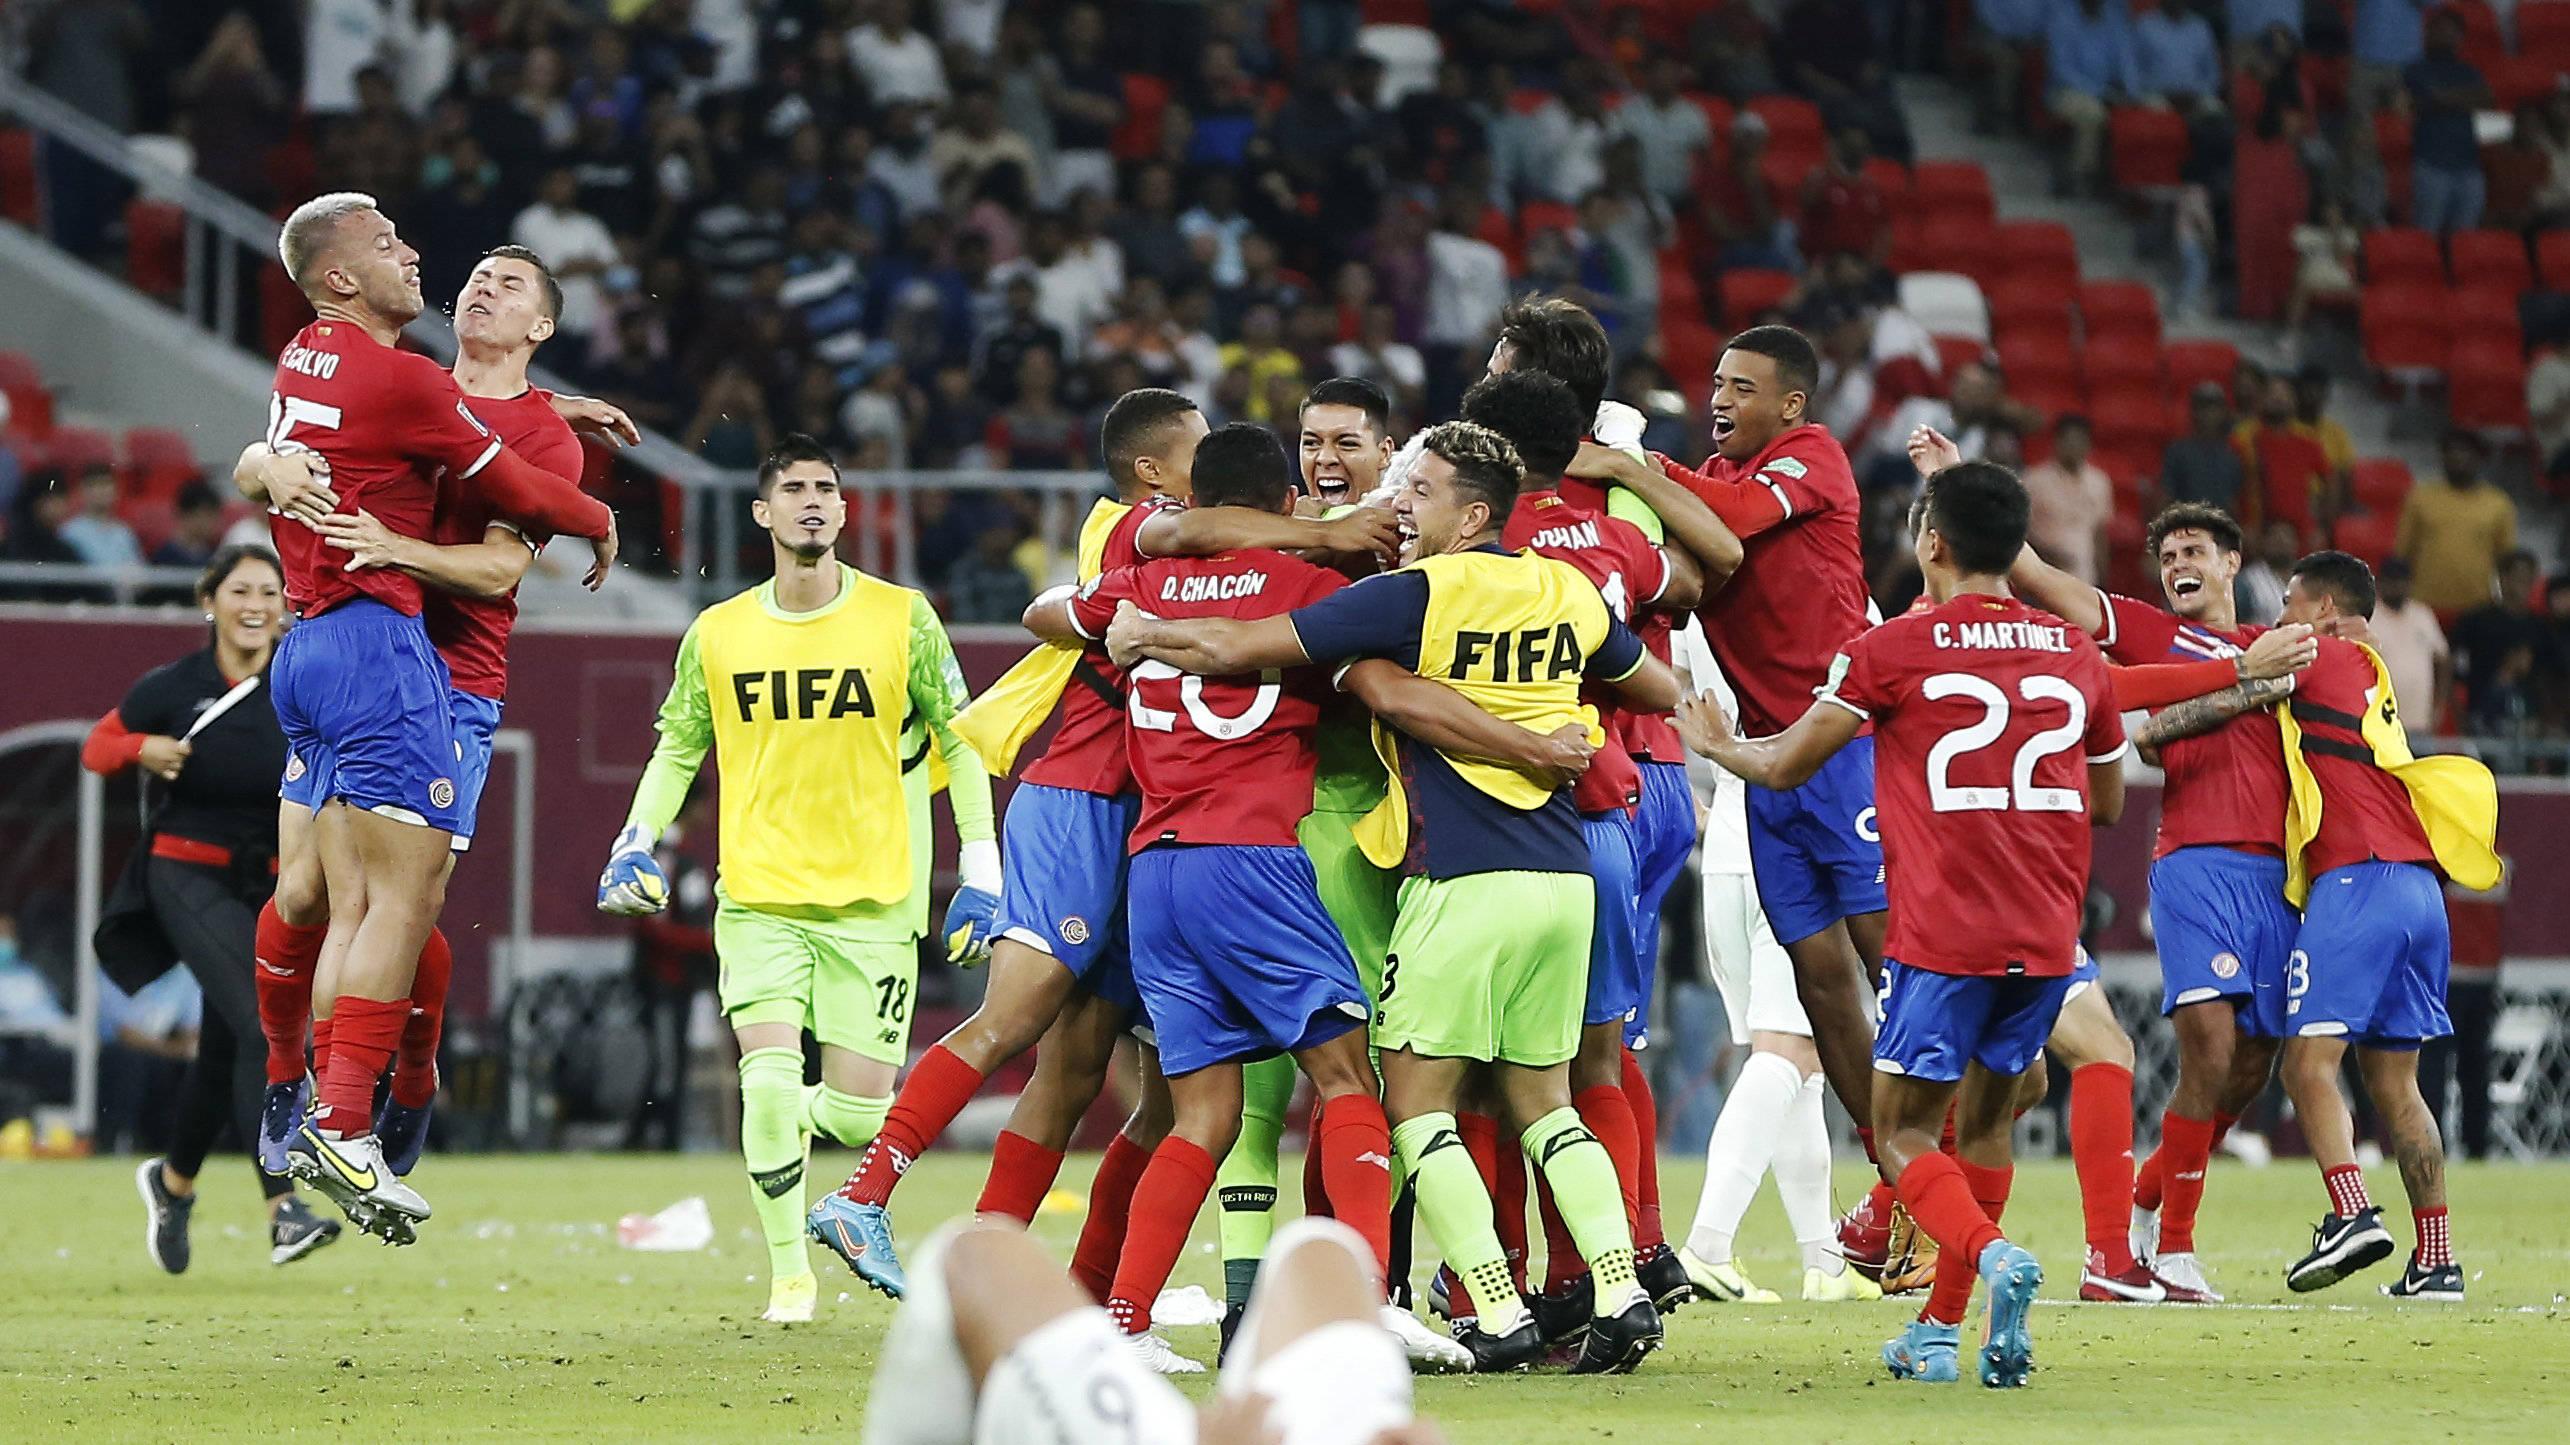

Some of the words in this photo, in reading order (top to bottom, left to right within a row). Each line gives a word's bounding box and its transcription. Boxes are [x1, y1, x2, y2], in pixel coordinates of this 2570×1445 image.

[1449, 622, 1581, 682] FIFA
[733, 668, 875, 722] FIFA
[1922, 672, 2085, 812] 22
[876, 974, 908, 1023] 18
